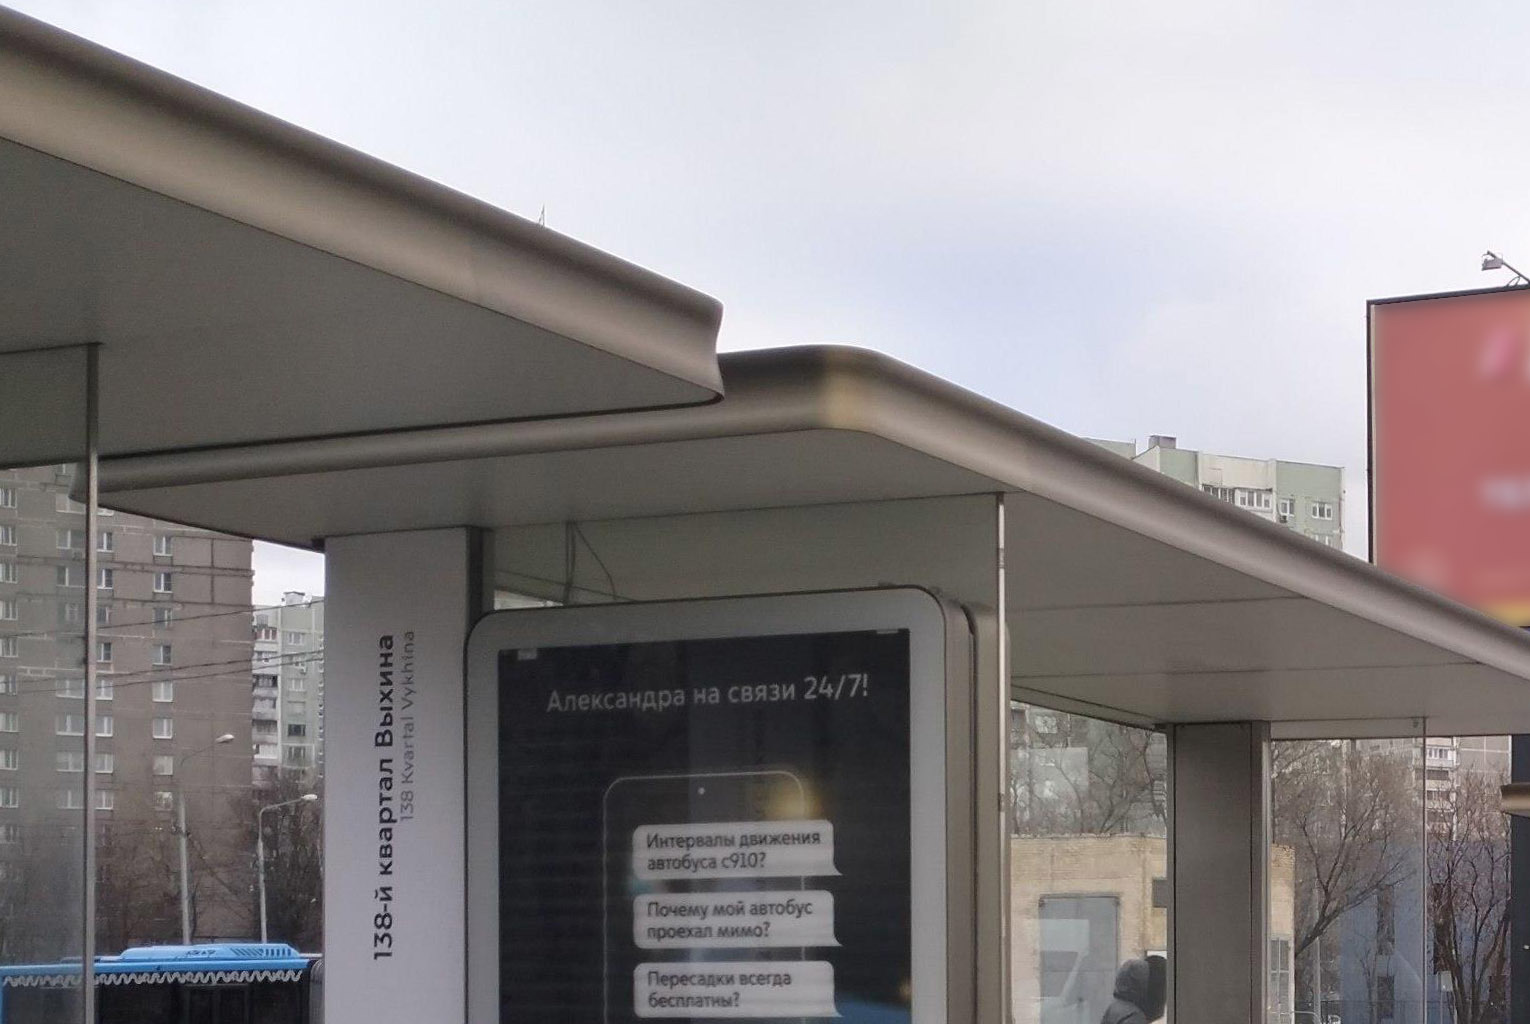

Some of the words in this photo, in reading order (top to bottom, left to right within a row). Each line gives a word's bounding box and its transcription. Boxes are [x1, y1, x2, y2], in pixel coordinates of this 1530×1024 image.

[400, 630, 417, 710] Vykhina
[375, 634, 394, 747] Выхина
[547, 687, 685, 712] Александра
[693, 685, 720, 704] на
[727, 682, 796, 703] связи
[803, 673, 868, 700] 24/7!
[400, 716, 415, 784] Kvartal
[379, 758, 397, 876] квартал
[400, 791, 415, 822] 138
[646, 832, 735, 850] Интервалы
[739, 831, 821, 849] движения
[647, 854, 717, 873] автобуса
[721, 851, 767, 869] с910?
[374, 886, 393, 961] 138-й
[647, 901, 708, 919] Почему
[712, 900, 746, 917] мой
[749, 898, 813, 918] автобус
[647, 925, 713, 942] проехал
[717, 920, 770, 938] мимо?
[647, 970, 735, 988] Пересадки
[740, 974, 793, 988] всегда
[647, 991, 740, 1009] бесплатны?
